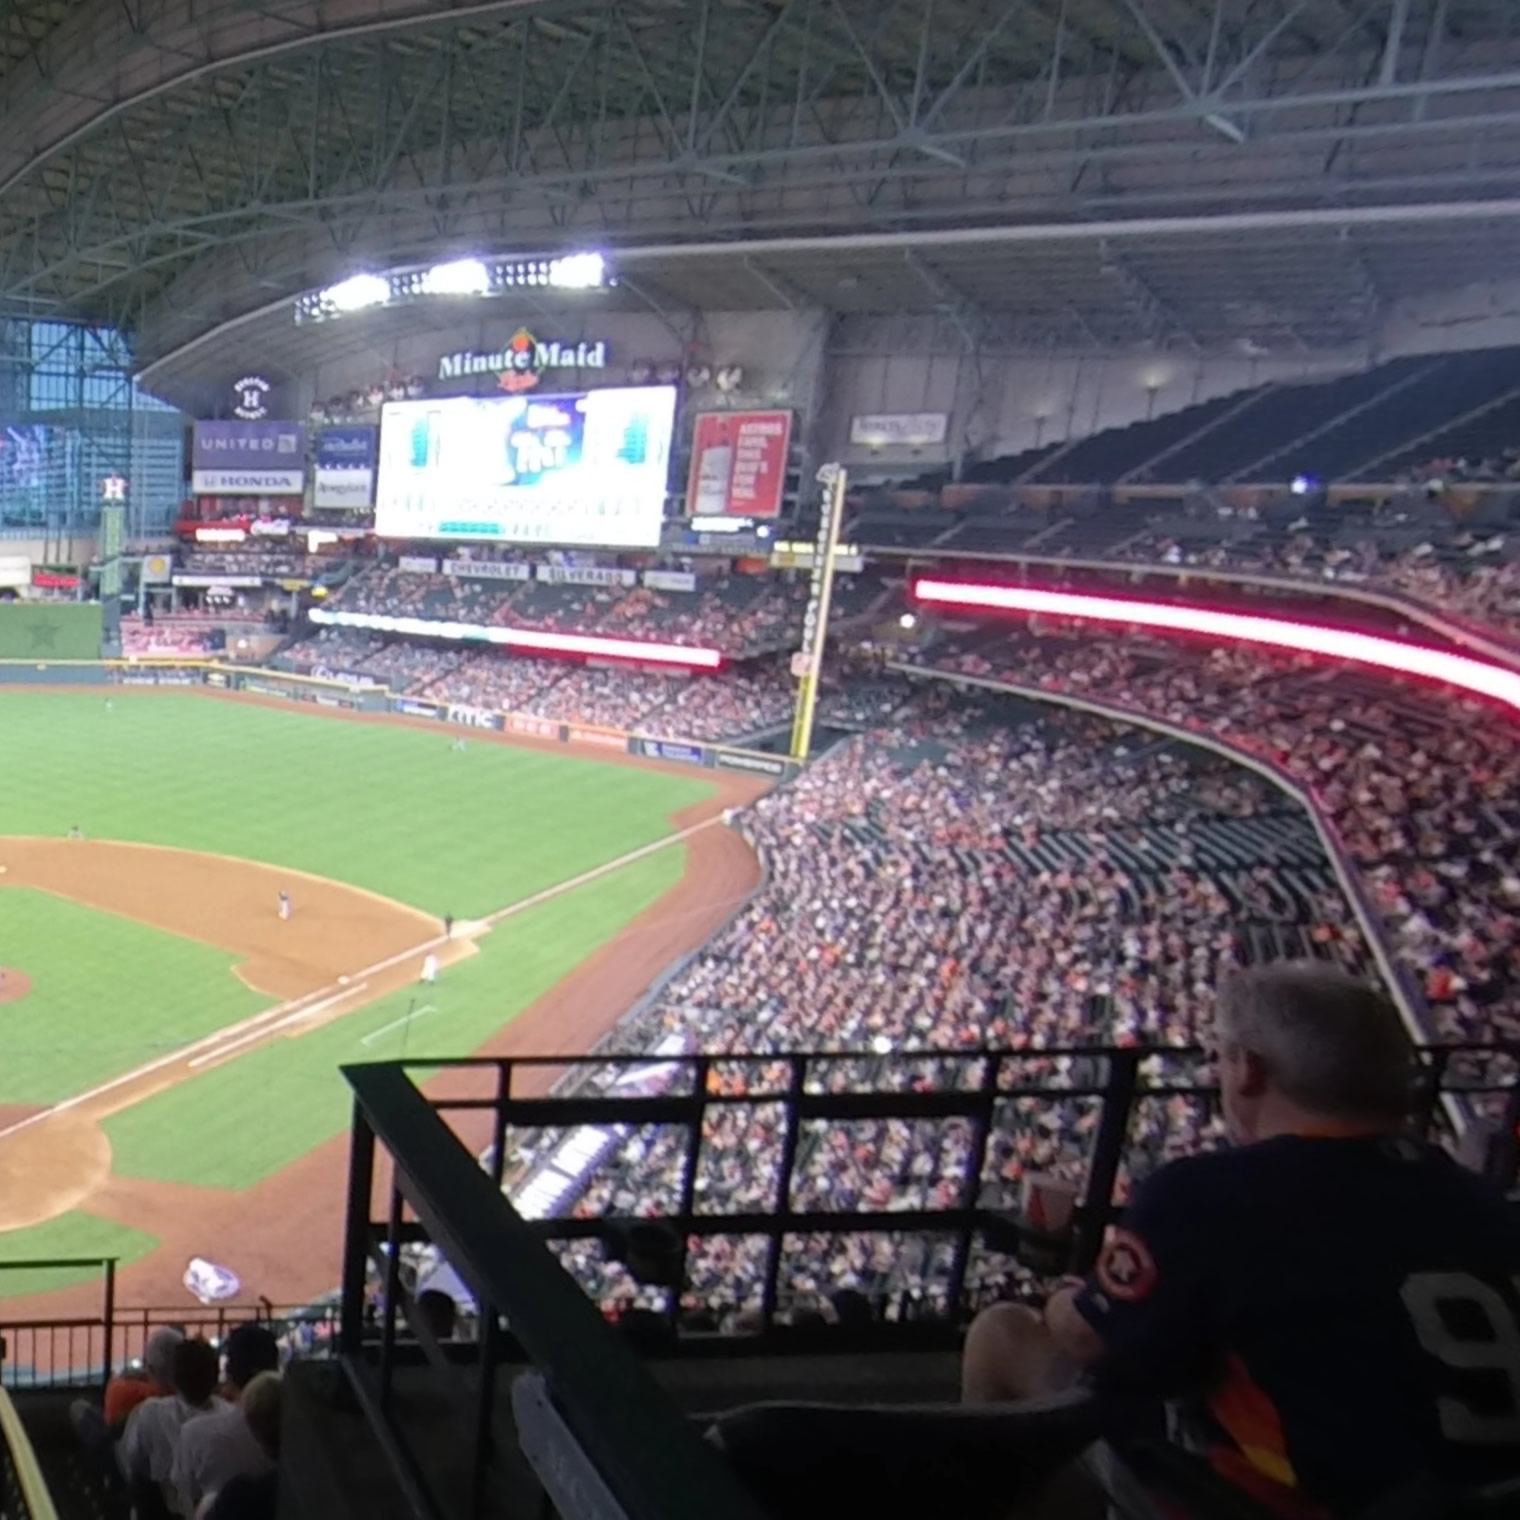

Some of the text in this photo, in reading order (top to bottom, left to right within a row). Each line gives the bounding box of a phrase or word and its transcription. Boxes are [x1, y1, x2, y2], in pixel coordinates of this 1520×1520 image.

[439, 342, 605, 379] Minute Maid
[243, 390, 260, 407] H
[201, 437, 276, 451] UNITED
[220, 476, 292, 488] HONDA
[450, 562, 625, 584] CHEVROLET SILVERADO
[1398, 1271, 1520, 1443] 9
